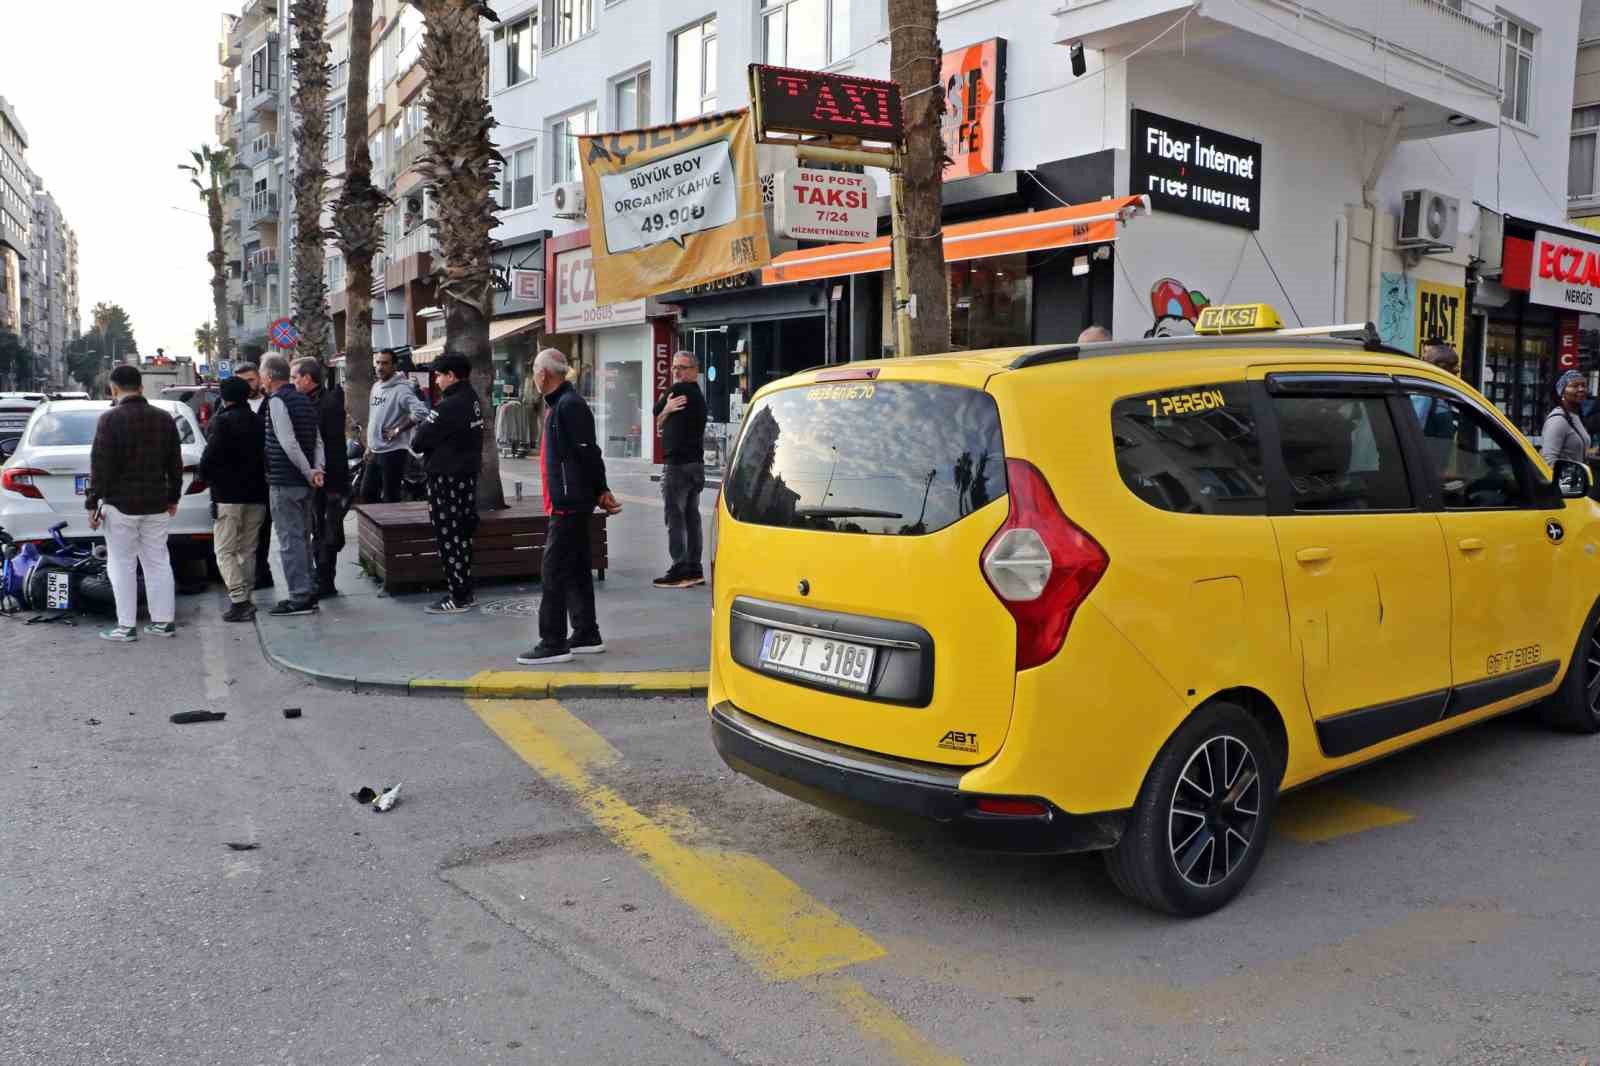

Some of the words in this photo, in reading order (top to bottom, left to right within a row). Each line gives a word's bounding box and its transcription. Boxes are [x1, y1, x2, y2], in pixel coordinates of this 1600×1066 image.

[1147, 127, 1191, 162] Fiber
[630, 166, 672, 190] BÜYÜK
[673, 156, 702, 176] BOY
[801, 173, 824, 183] BIG
[829, 176, 863, 186] POST
[615, 187, 675, 213] ORGANİK
[678, 172, 722, 197] KAHVE
[793, 185, 868, 209] TAKSİ
[816, 210, 848, 223] 7/24
[559, 258, 595, 305] ECZ
[1539, 241, 1600, 289] ECZA
[1565, 288, 1593, 306] NERGİS
[1421, 291, 1459, 341] FAST
[1147, 400, 1157, 418] 7
[1161, 389, 1225, 416] PERSON
[770, 632, 792, 661] 07
[800, 638, 813, 666] T
[820, 642, 868, 679] 3189
[939, 730, 977, 745] ABT
